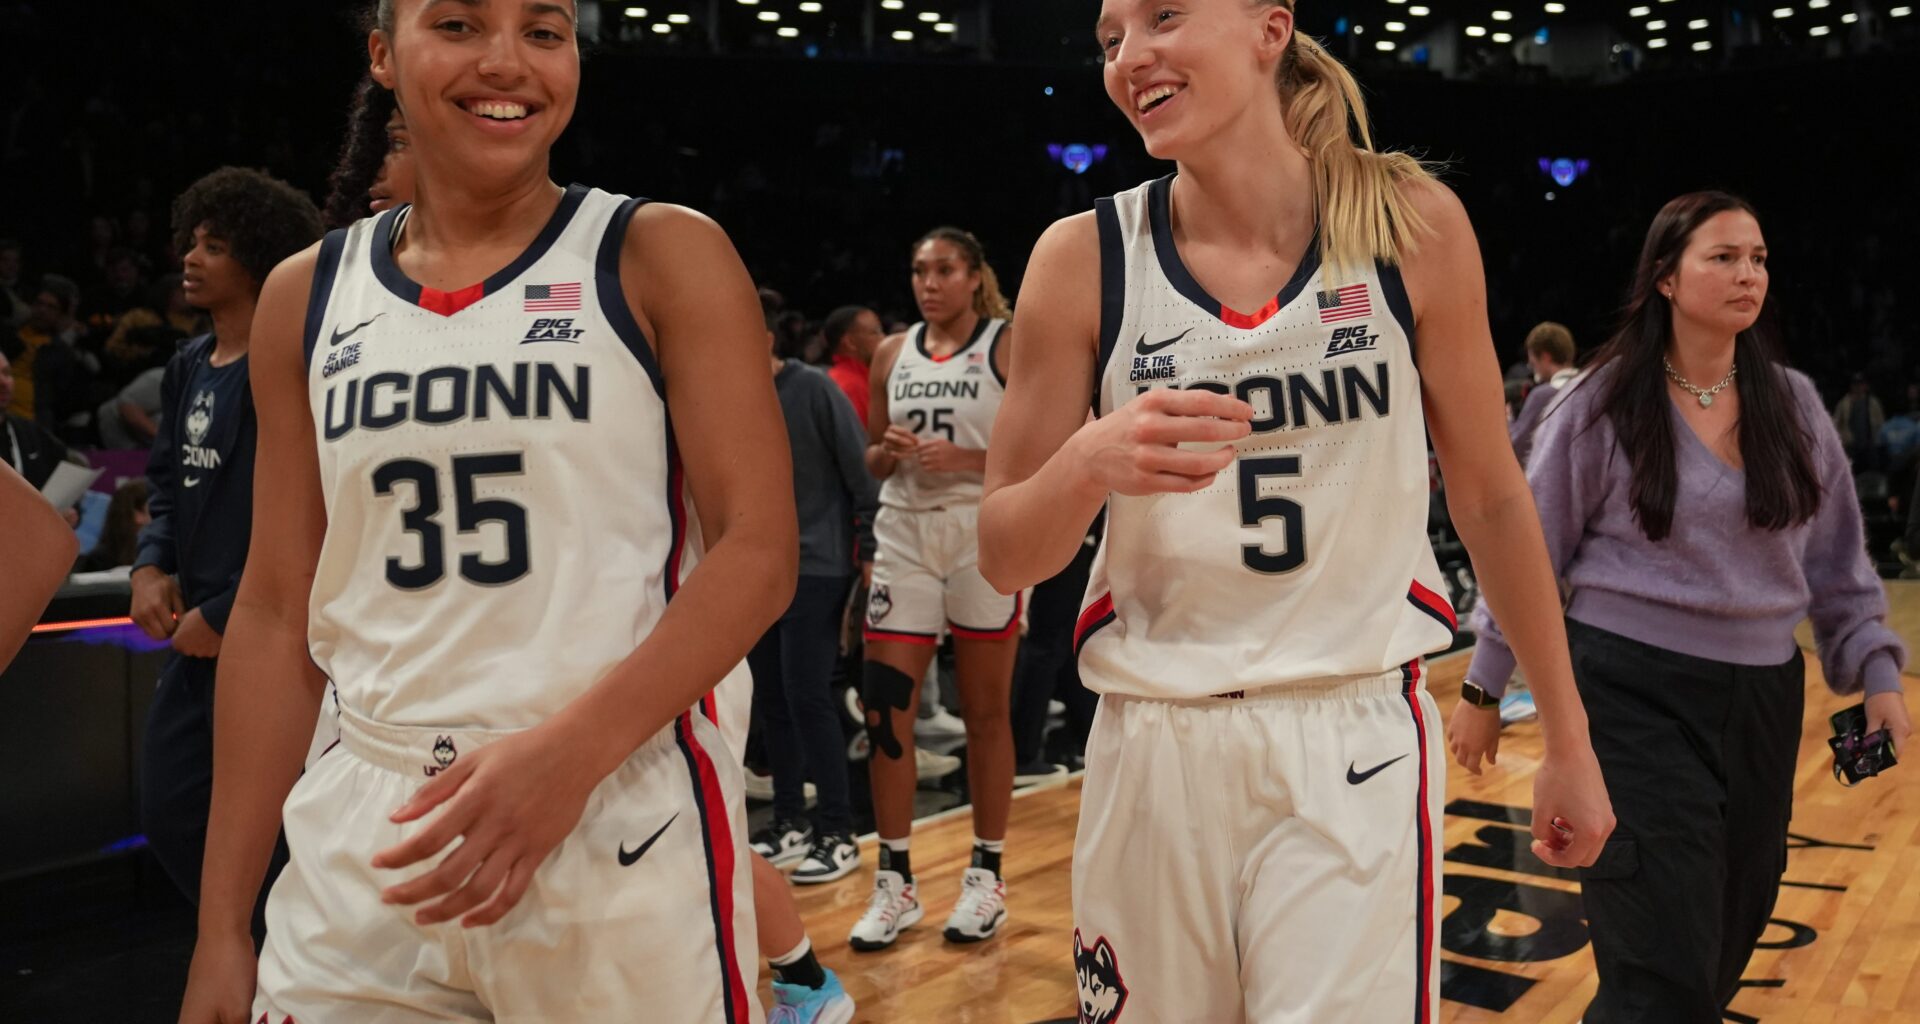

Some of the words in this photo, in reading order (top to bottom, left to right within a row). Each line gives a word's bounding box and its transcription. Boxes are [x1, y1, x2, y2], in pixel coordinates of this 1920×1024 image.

[532, 318, 575, 329] BIG
[1331, 325, 1368, 340] BIG
[524, 329, 586, 339] EAST
[1326, 334, 1380, 352] EAST
[341, 341, 363, 357] THE
[322, 352, 362, 378] CHANGE
[1133, 357, 1149, 369] BE
[1152, 355, 1175, 368] THE
[1129, 366, 1176, 381] CHANGE
[895, 381, 979, 401] UCONN
[1136, 361, 1390, 436] ONN
[324, 361, 591, 442] UCONN
[371, 450, 533, 592] 35
[1237, 454, 1308, 576] 5
